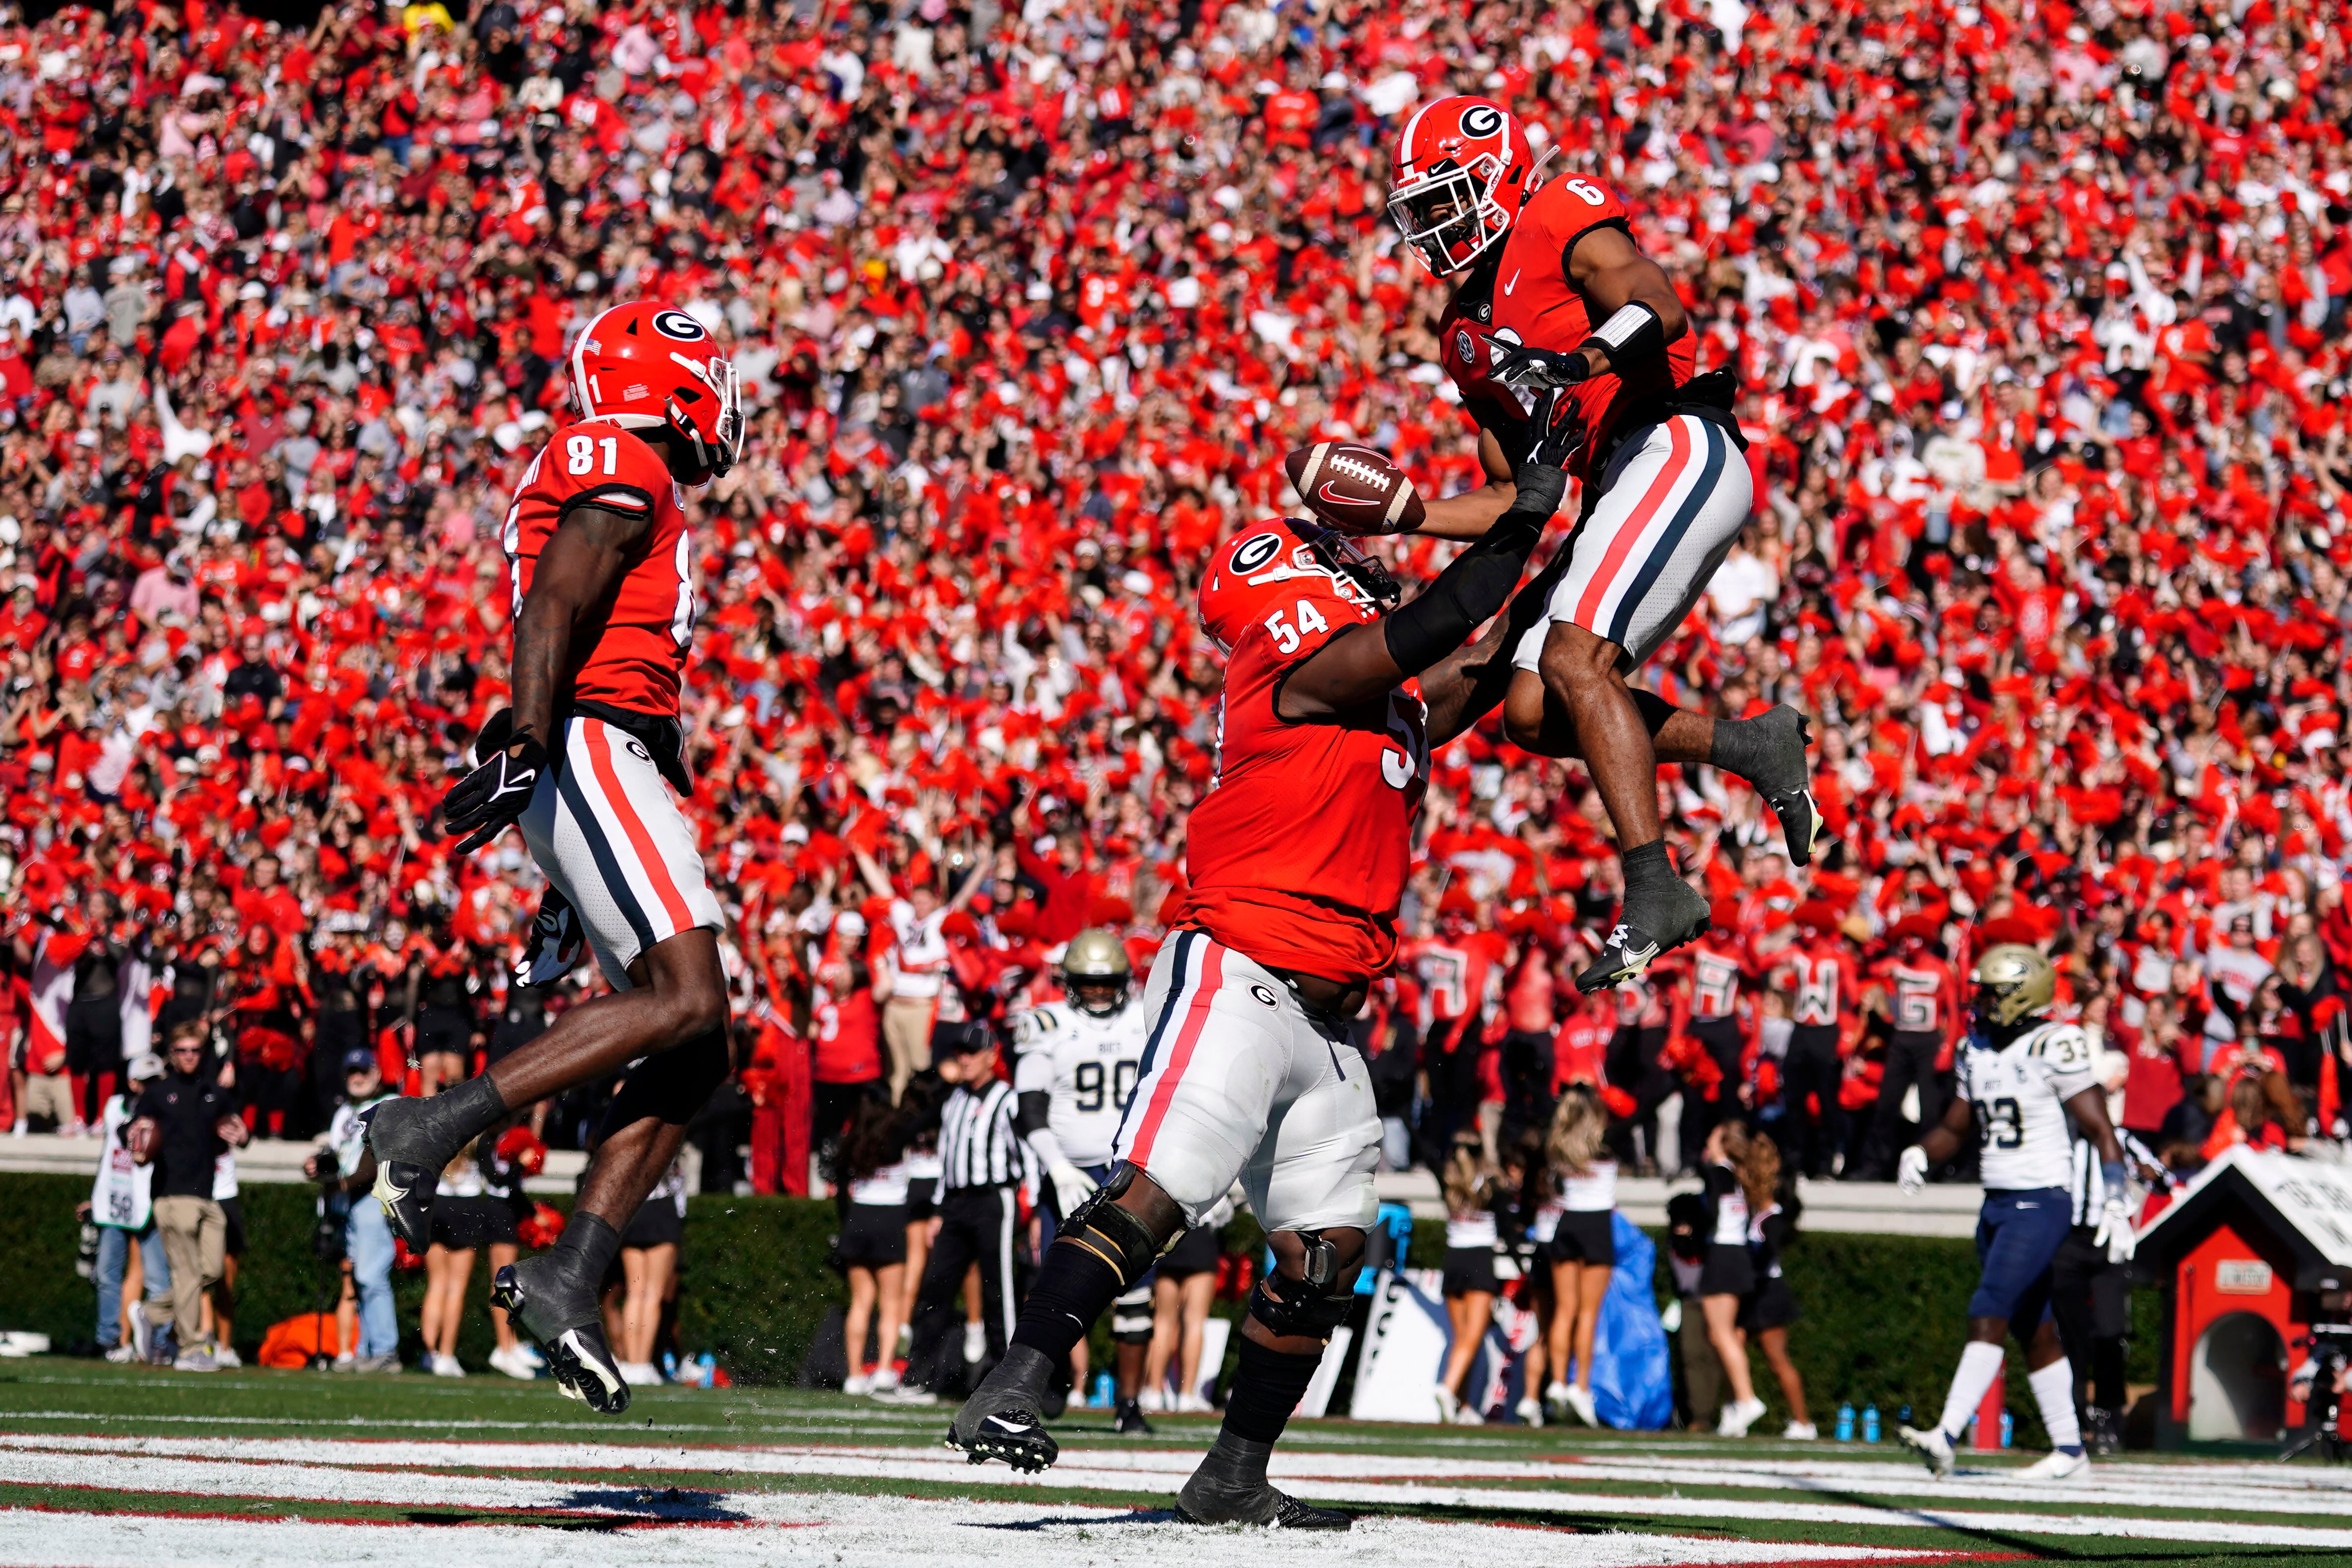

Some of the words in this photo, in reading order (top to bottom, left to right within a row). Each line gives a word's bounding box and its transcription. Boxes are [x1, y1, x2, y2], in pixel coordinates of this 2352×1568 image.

[1459, 106, 1503, 139] G
[1565, 178, 1606, 206] 6
[652, 310, 705, 342] G
[1479, 304, 1491, 321] G
[566, 435, 617, 476] 81
[1229, 533, 1283, 576] G
[1264, 598, 1330, 654] 54
[623, 739, 652, 765] G
[1246, 982, 1280, 1011] G
[1075, 1060, 1140, 1111] 90
